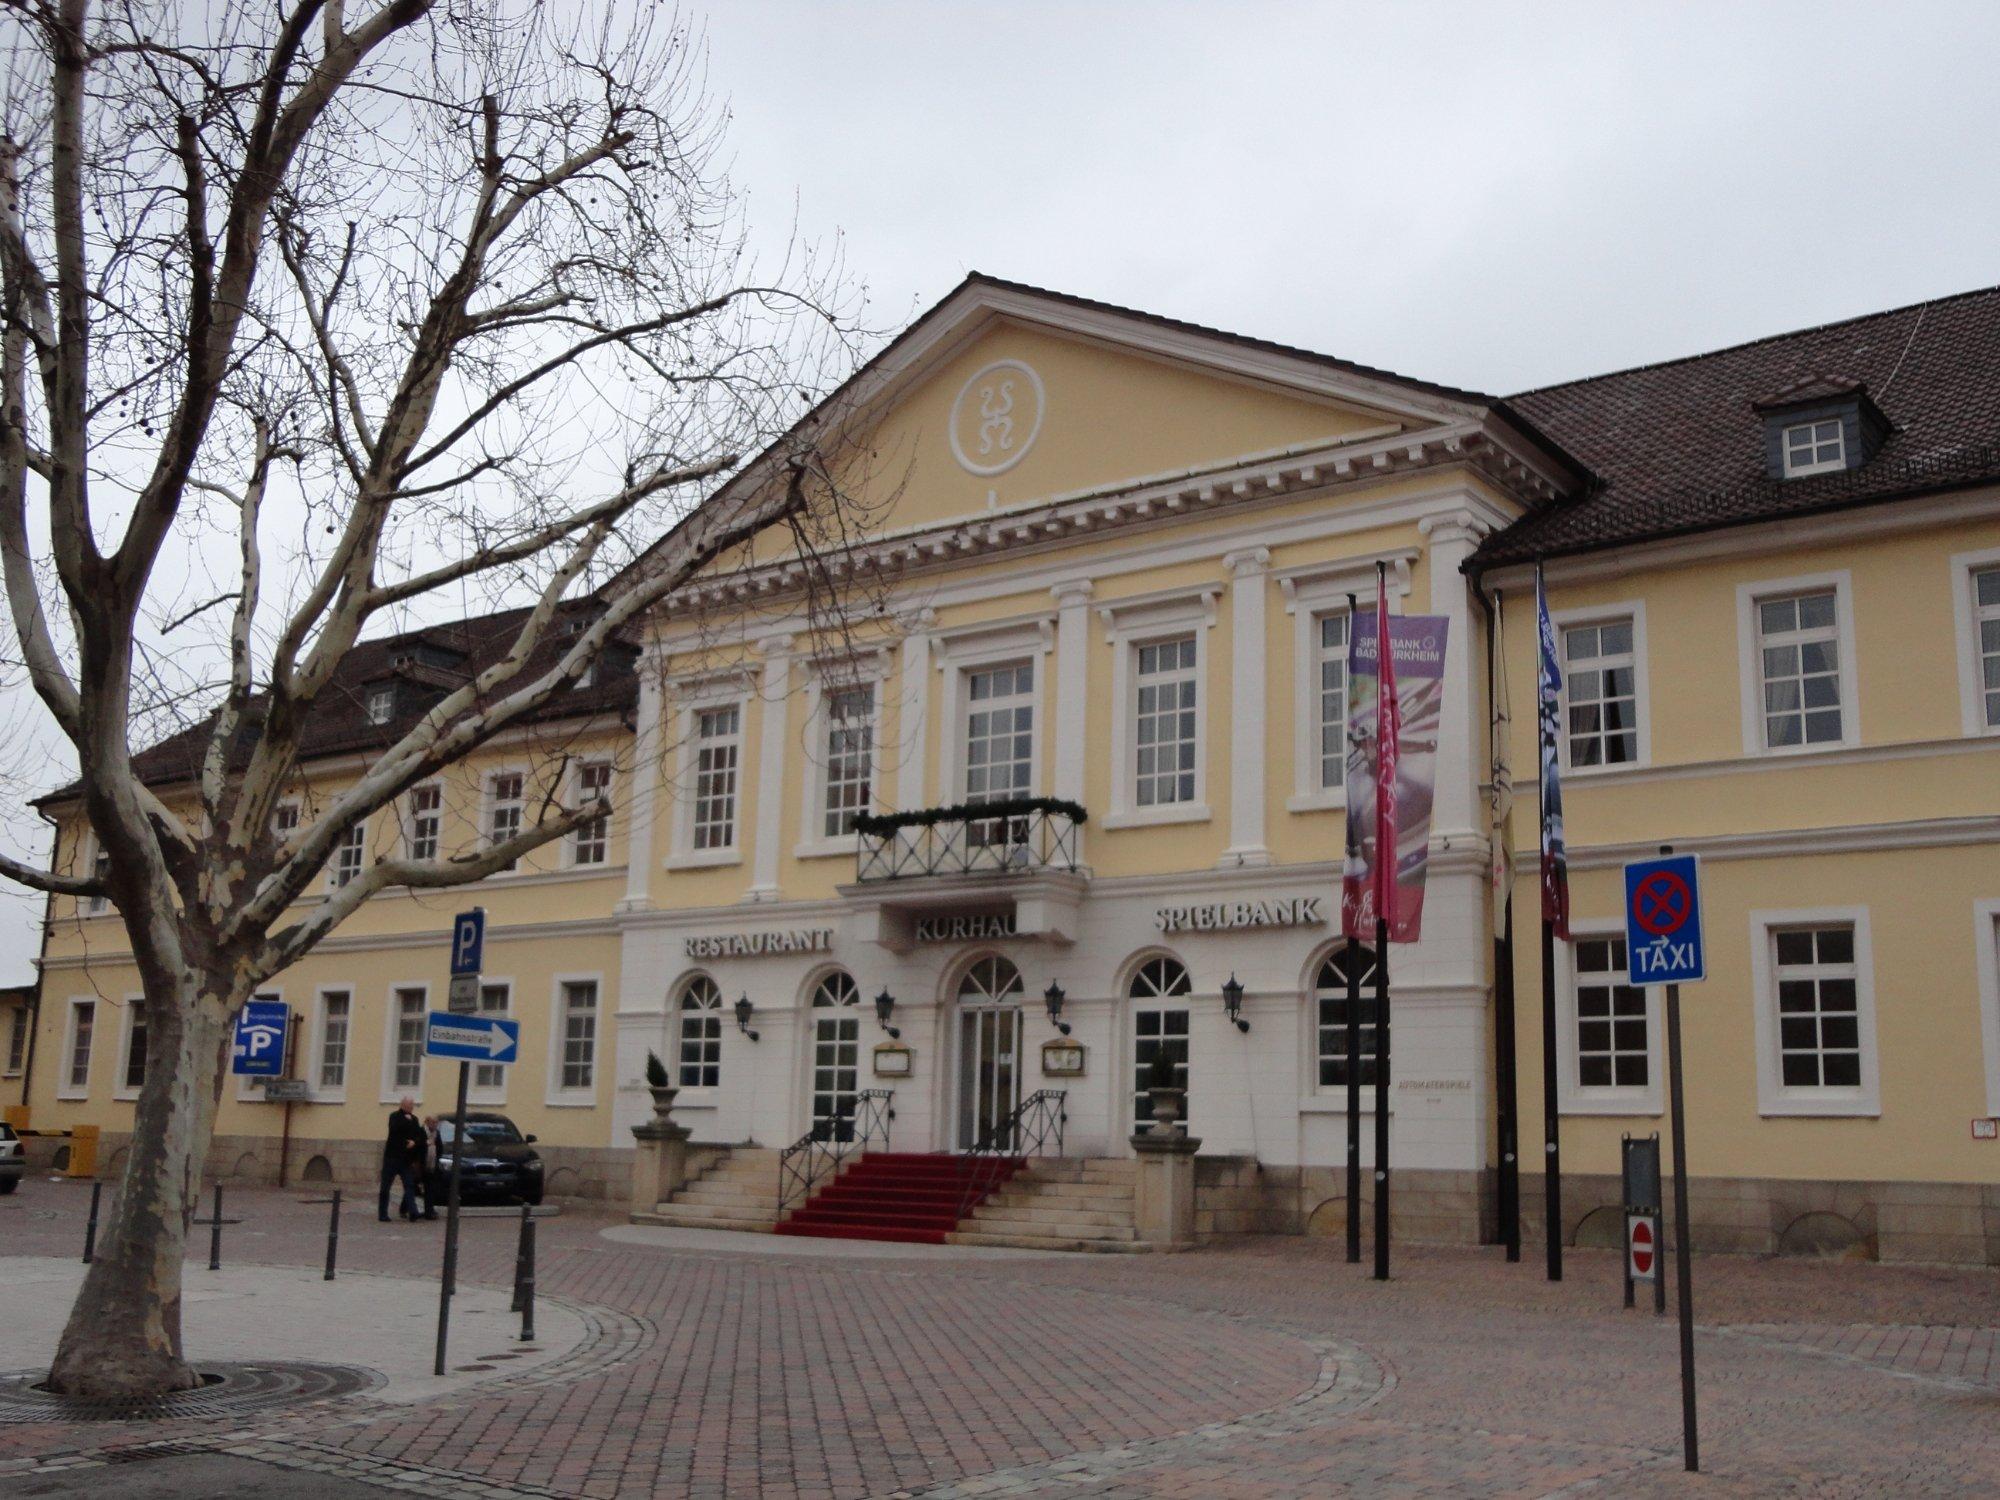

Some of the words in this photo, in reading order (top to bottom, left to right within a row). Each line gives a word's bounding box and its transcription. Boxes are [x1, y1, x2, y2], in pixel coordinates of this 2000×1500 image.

[916, 914, 1017, 941] KURHAU
[1155, 897, 1321, 932] SPIELBANK
[457, 920, 477, 967] P
[685, 928, 833, 958] RESTAURANT
[1635, 942, 1695, 973] TAXI
[250, 1031, 272, 1057] P
[432, 1028, 492, 1045] Einbahnstraße
